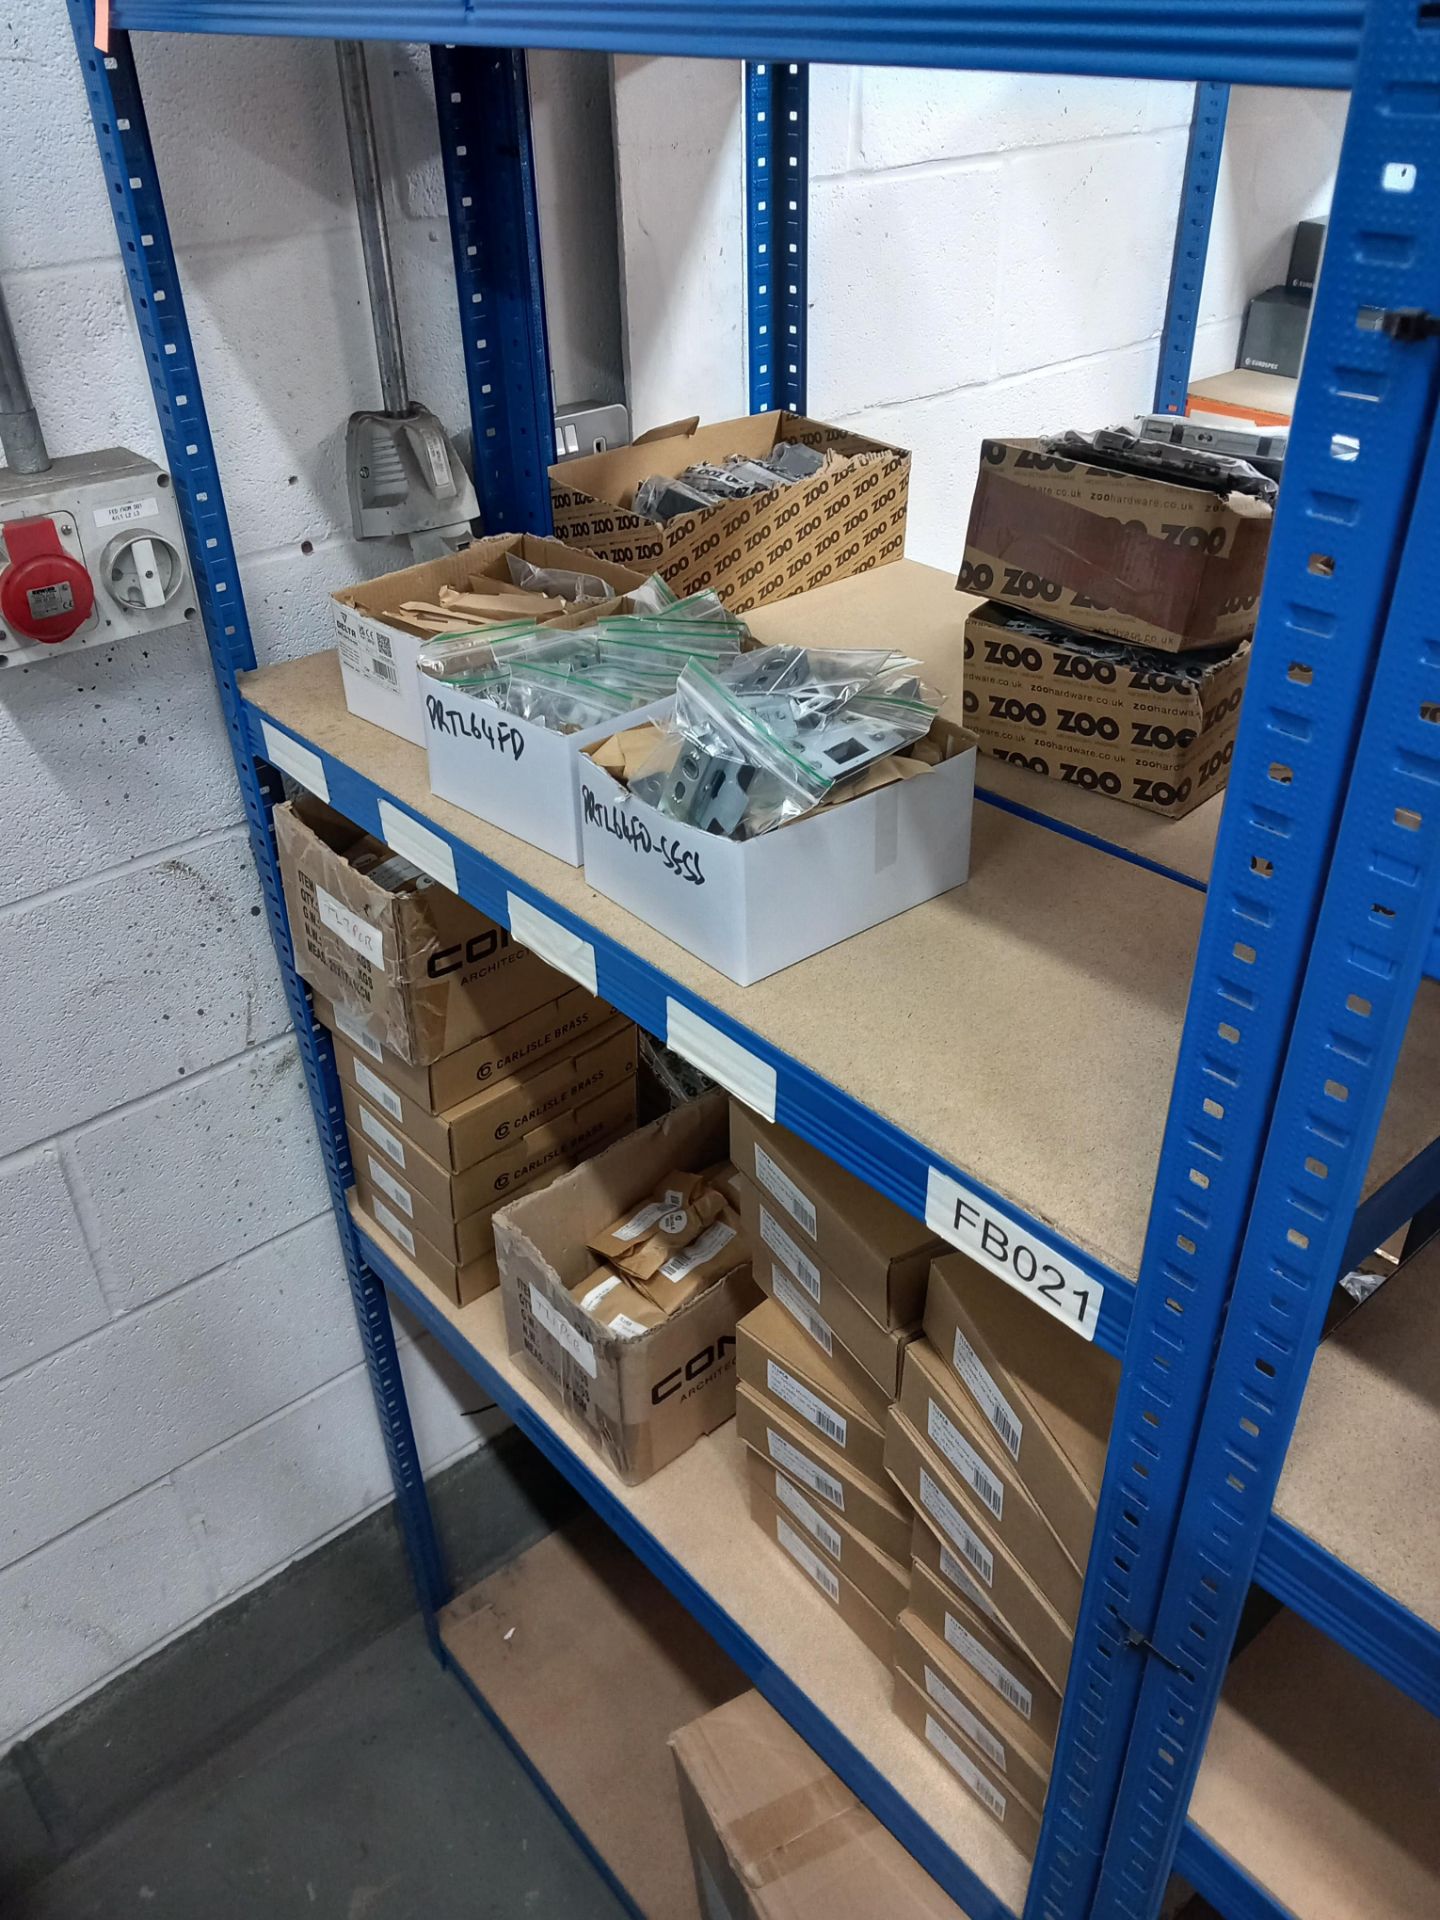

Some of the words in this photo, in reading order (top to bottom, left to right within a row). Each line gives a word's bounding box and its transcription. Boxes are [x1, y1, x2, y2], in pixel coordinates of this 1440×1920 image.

[1251, 359, 1278, 370] EUROSPEC
[552, 493, 572, 509] ZOO
[570, 522, 590, 536] ZOO
[591, 518, 613, 534] ZOO
[615, 515, 640, 530] ZOO
[666, 519, 695, 548] ZOO
[692, 533, 720, 561] ZOO
[723, 510, 751, 538] ZOO
[752, 488, 779, 515] ZOO
[714, 548, 742, 576] ZOO
[744, 525, 771, 552] ZOO
[774, 502, 800, 529] ZOO
[803, 480, 829, 508] ZOO
[738, 561, 764, 588] ZOO
[767, 538, 792, 565] ZOO
[796, 516, 822, 542] ZOO
[824, 494, 850, 520] ZOO
[853, 473, 879, 499] ZOO
[758, 574, 784, 600] ZOO
[787, 552, 812, 578] ZOO
[815, 530, 841, 556] ZOO
[843, 509, 868, 535] ZOO
[871, 488, 896, 513] ZOO
[878, 534, 903, 559] ZOO
[1161, 523, 1227, 555] ZOO
[611, 547, 633, 562] ZOO
[635, 542, 663, 560] ZOO
[807, 564, 832, 588] ZOO
[835, 542, 860, 568] ZOO
[863, 521, 887, 547] ZOO
[1001, 568, 1063, 602] ZOO
[336, 620, 357, 638] DELTA
[984, 641, 1043, 672] ZOO
[1053, 653, 1117, 685] ZOO
[988, 695, 1047, 727] ZOO
[1056, 709, 1120, 741] ZOO
[1030, 684, 1124, 708] zoohardware.co.uk
[426, 694, 525, 761] PRTL64FD
[1034, 738, 1126, 763] zoohardware.co.uk
[1059, 763, 1122, 795] ZOO
[1133, 778, 1193, 807] ZOO
[496, 1035, 551, 1070] CARLISLE
[555, 1013, 589, 1038] BRASS
[514, 1093, 567, 1128] CARLISLE
[571, 1070, 604, 1095] BRASS
[954, 1198, 1089, 1322] FB021
